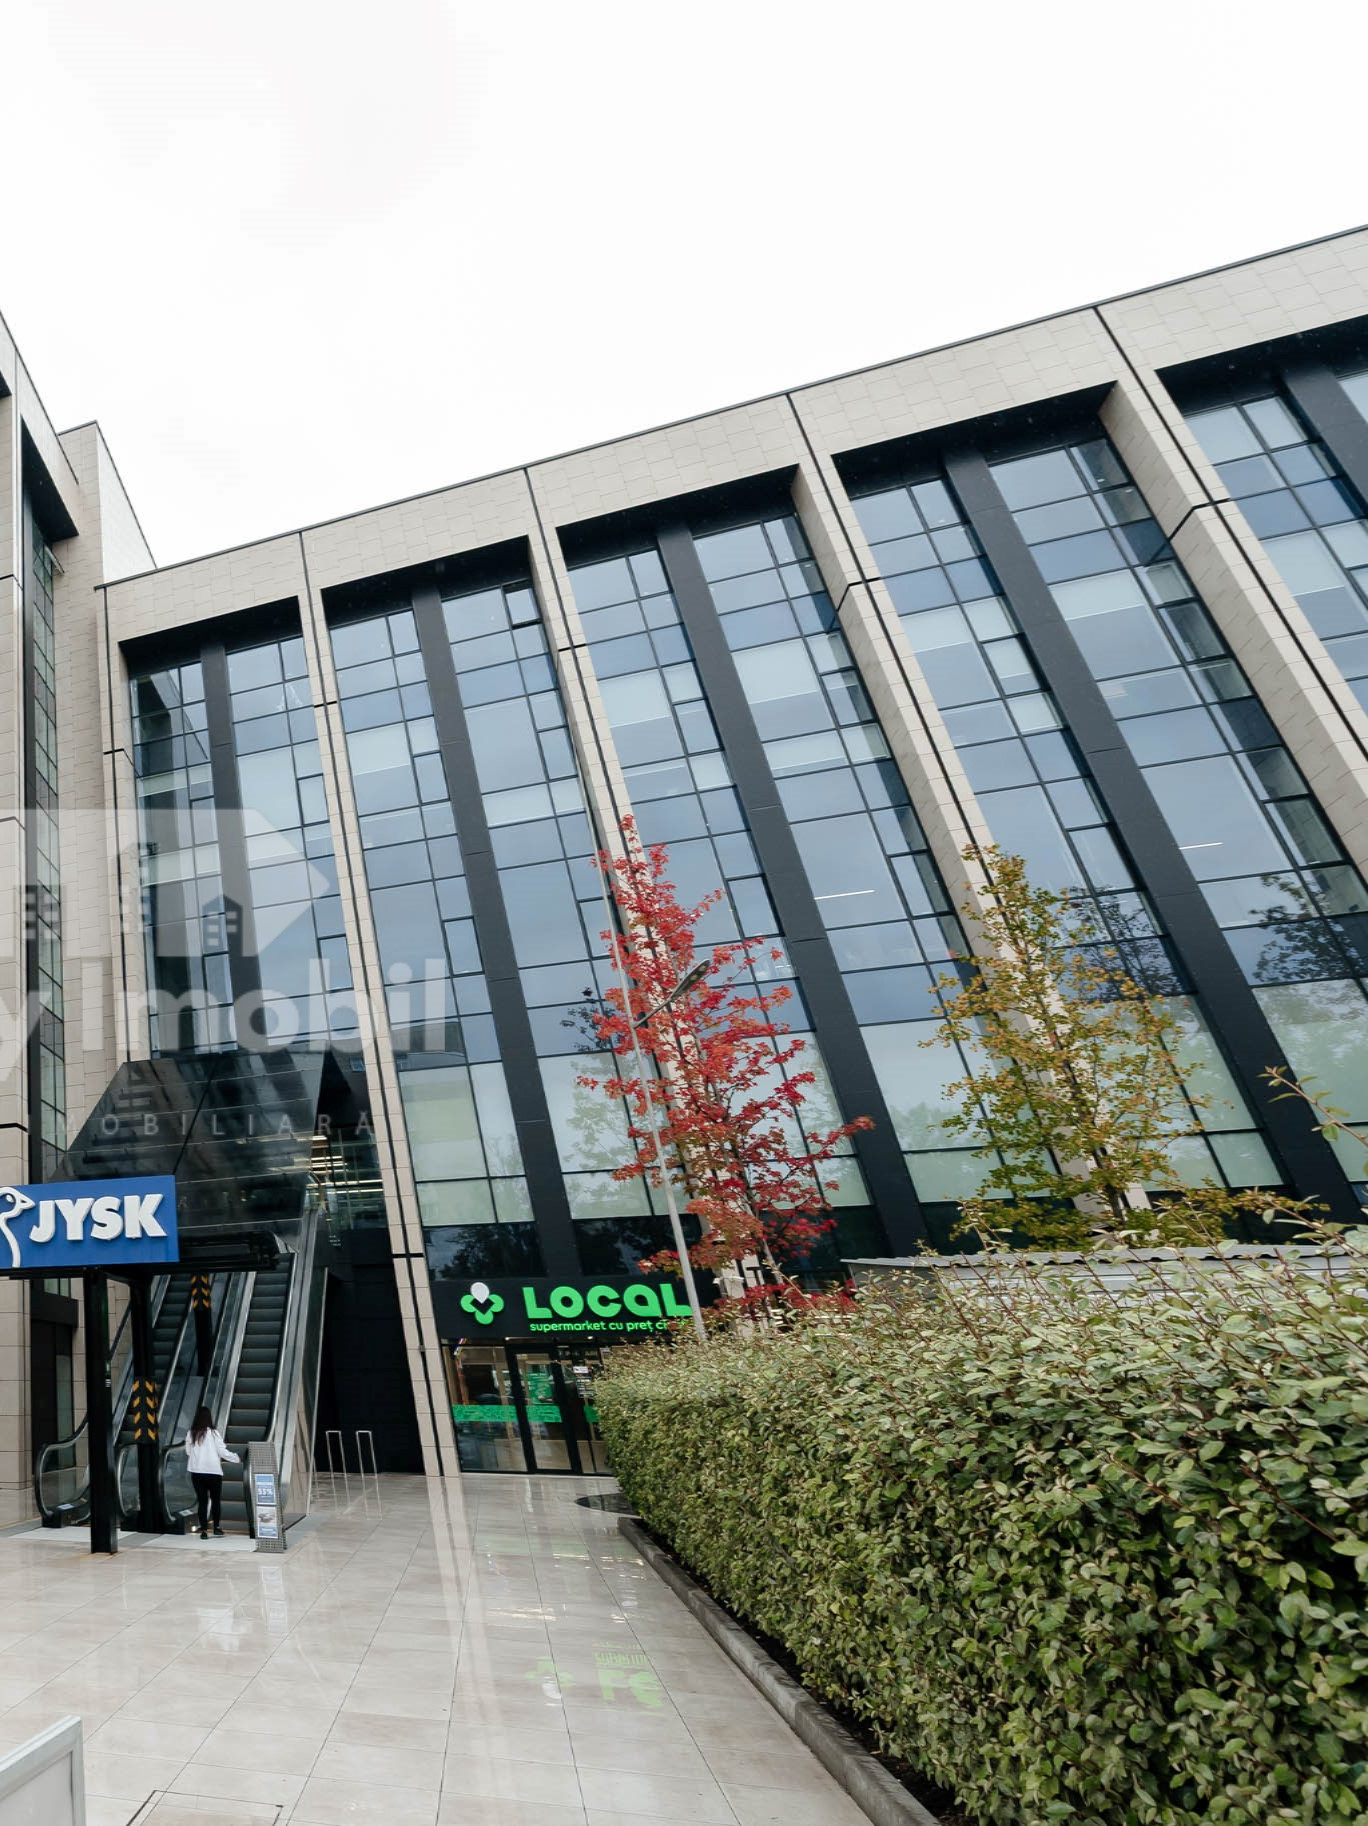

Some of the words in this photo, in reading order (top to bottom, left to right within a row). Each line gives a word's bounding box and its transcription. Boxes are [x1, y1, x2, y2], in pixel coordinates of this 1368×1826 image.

[29, 1193, 168, 1243] JYSK
[529, 1320, 606, 1332] supermarket
[608, 1321, 624, 1331] cu
